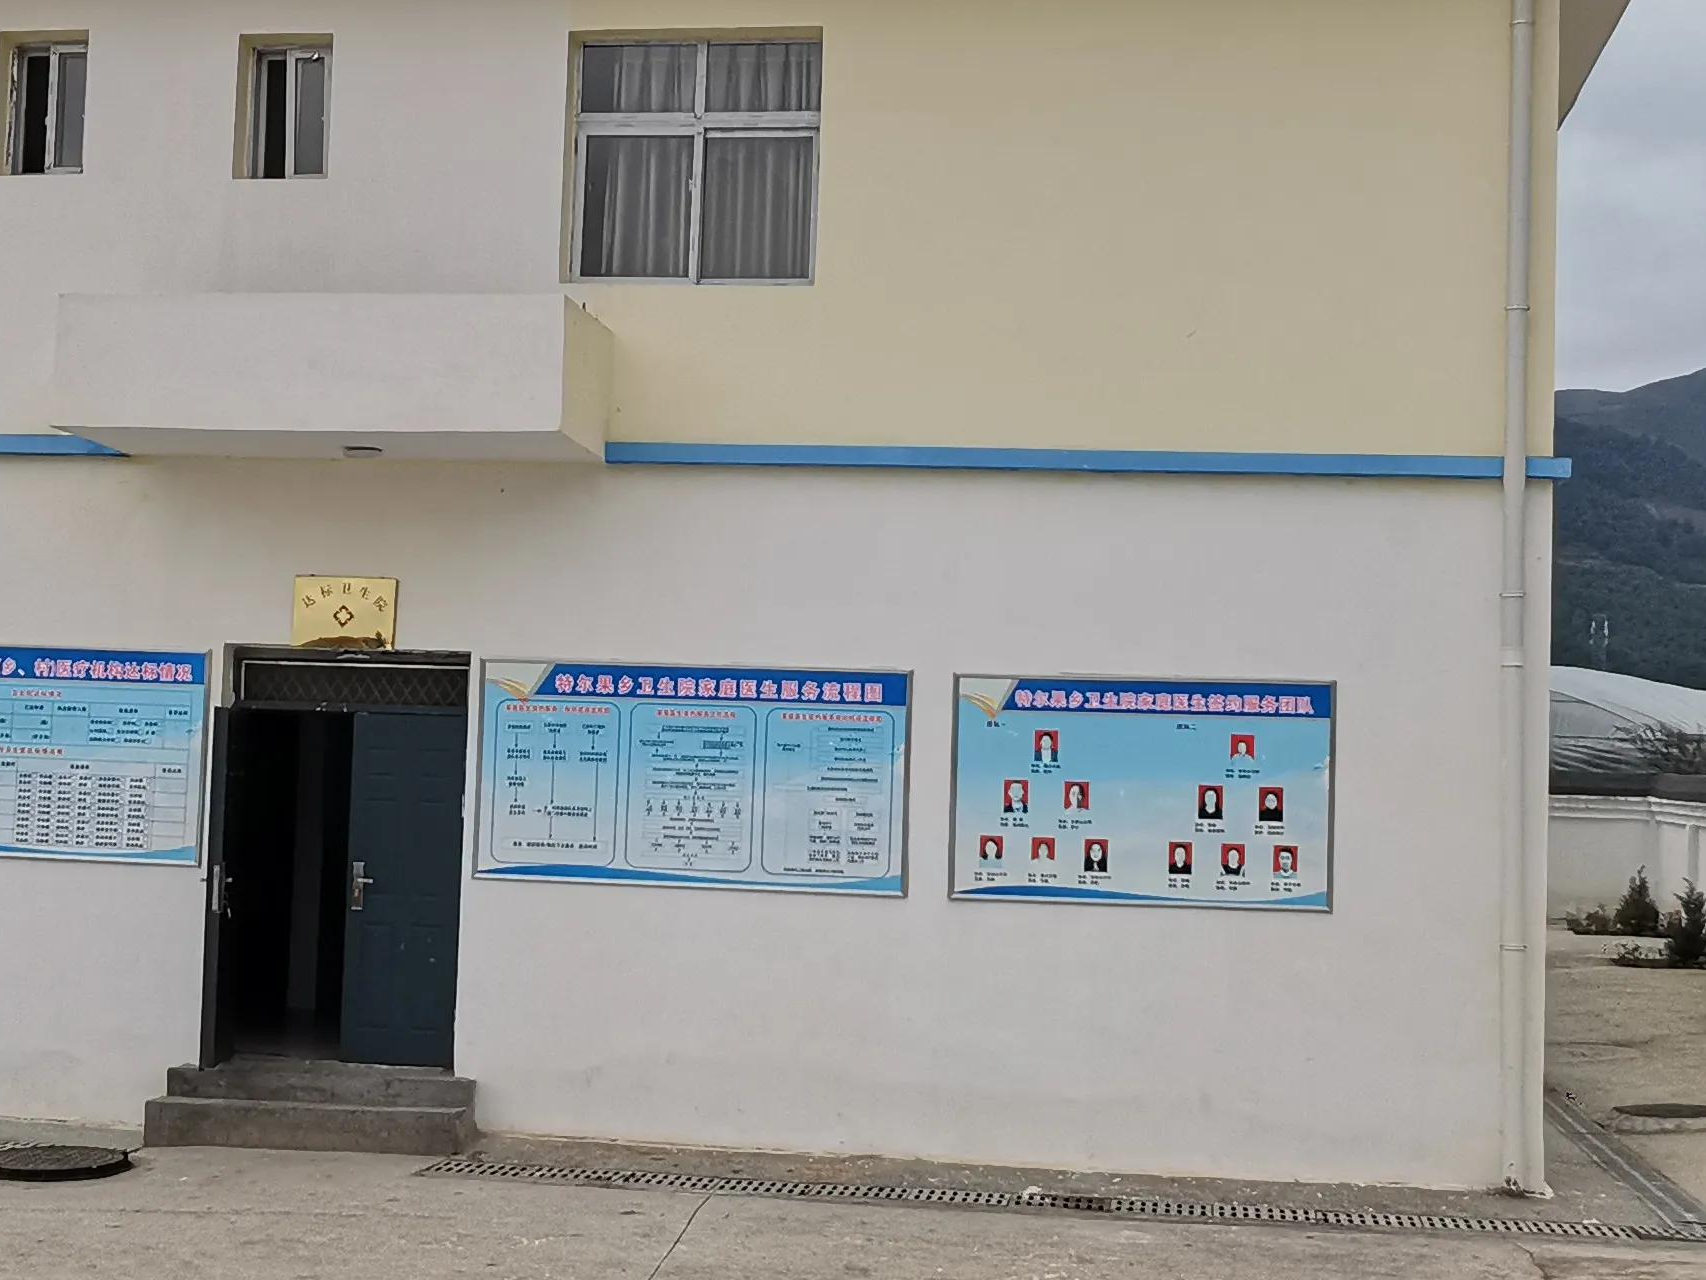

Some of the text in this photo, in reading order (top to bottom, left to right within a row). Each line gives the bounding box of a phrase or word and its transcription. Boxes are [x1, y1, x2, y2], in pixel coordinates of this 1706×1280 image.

[554, 673, 883, 703] 特尔果乡卫生院家庭医生服务流程图
[1014, 689, 1315, 715] 特尔果乡卫生院家庭医生签约服务团队
